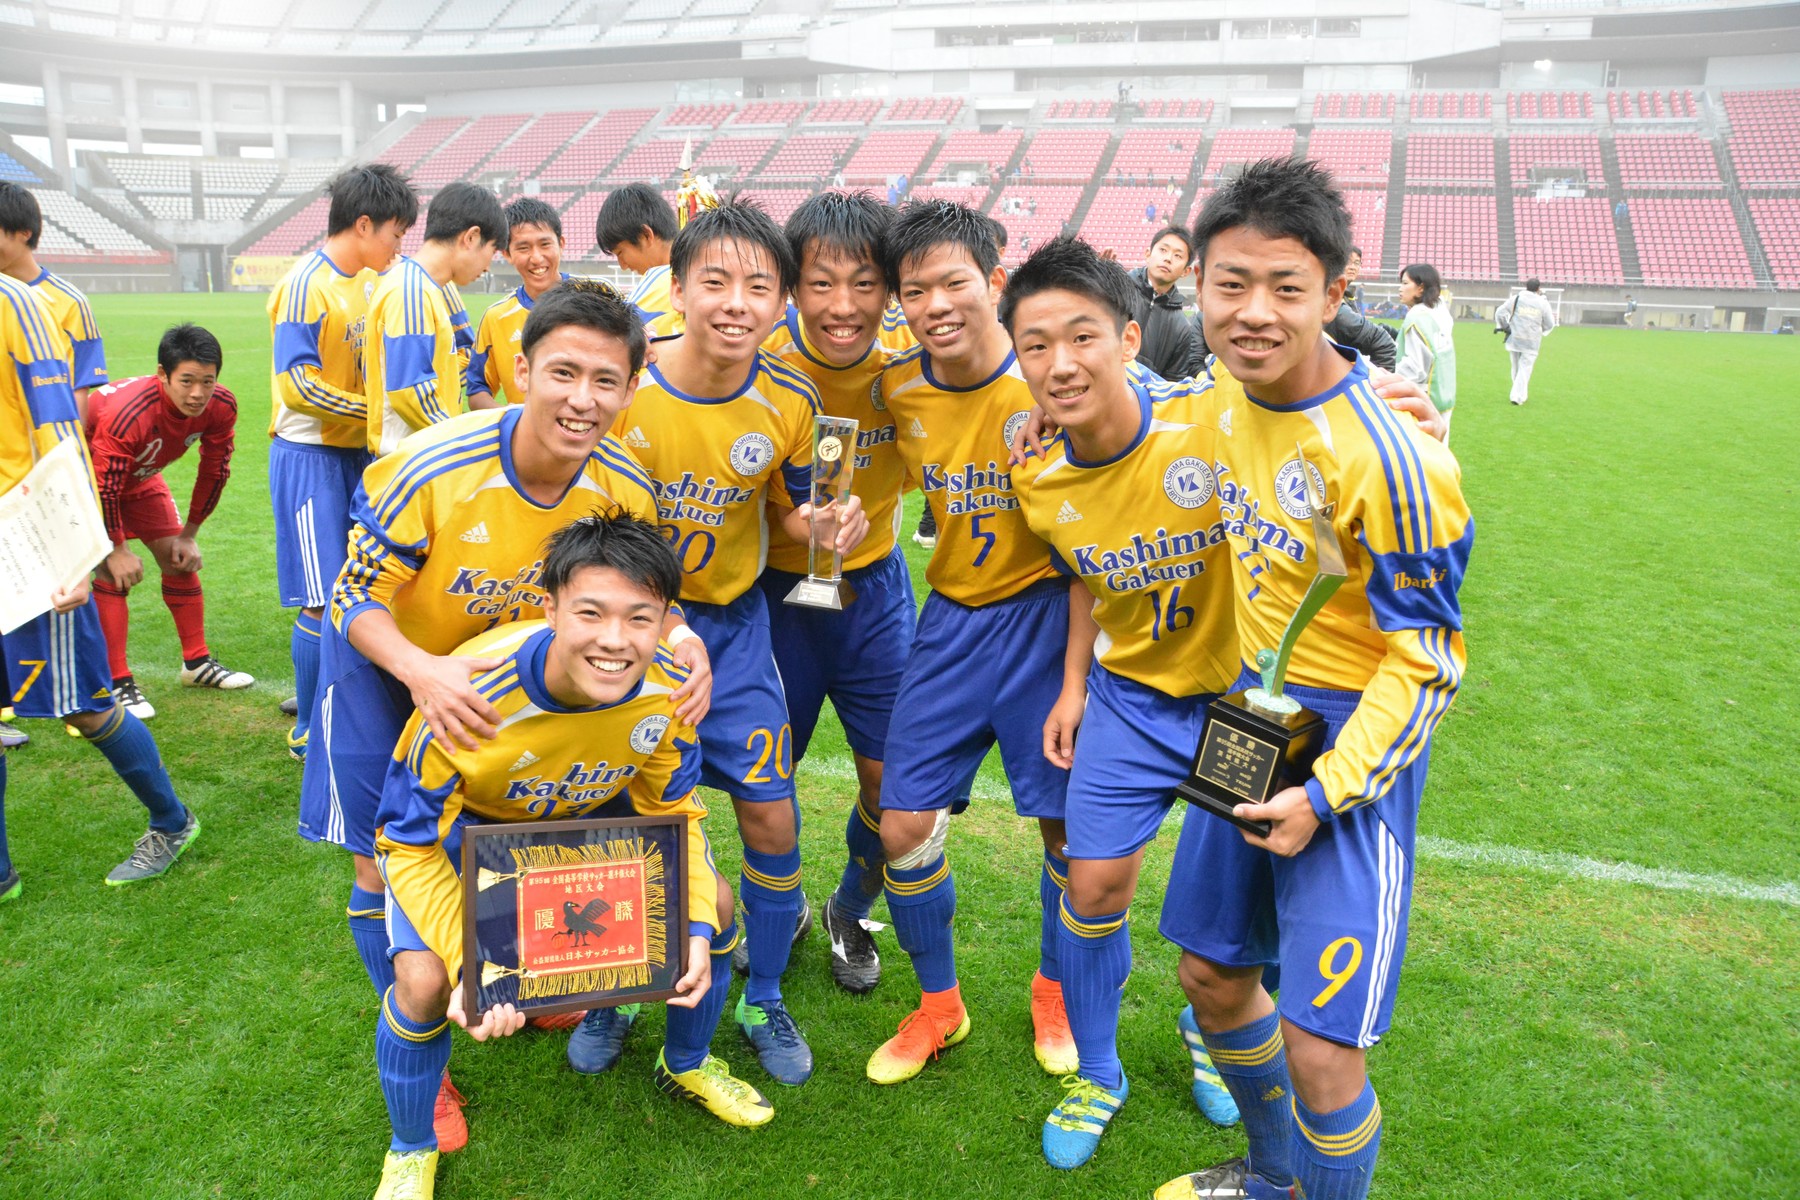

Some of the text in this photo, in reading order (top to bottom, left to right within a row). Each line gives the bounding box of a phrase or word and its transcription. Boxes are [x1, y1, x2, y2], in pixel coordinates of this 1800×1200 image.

[732, 434, 758, 453] KASHIMA
[652, 471, 756, 507] ashima
[1165, 459, 1213, 507] KASHIMA GAKUEN FOOTBALL CLUB
[1276, 483, 1286, 505] CLUB
[947, 491, 1021, 515] akuen
[1284, 503, 1312, 517] OTBALL
[971, 512, 996, 567] 5
[1071, 526, 1229, 577] Kashima
[1105, 558, 1206, 593] Gakuen
[1143, 585, 1196, 642] 16
[11, 660, 47, 703] 7
[741, 722, 793, 784] 20
[564, 881, 605, 894] 地区大会
[1311, 936, 1363, 1008] 9
